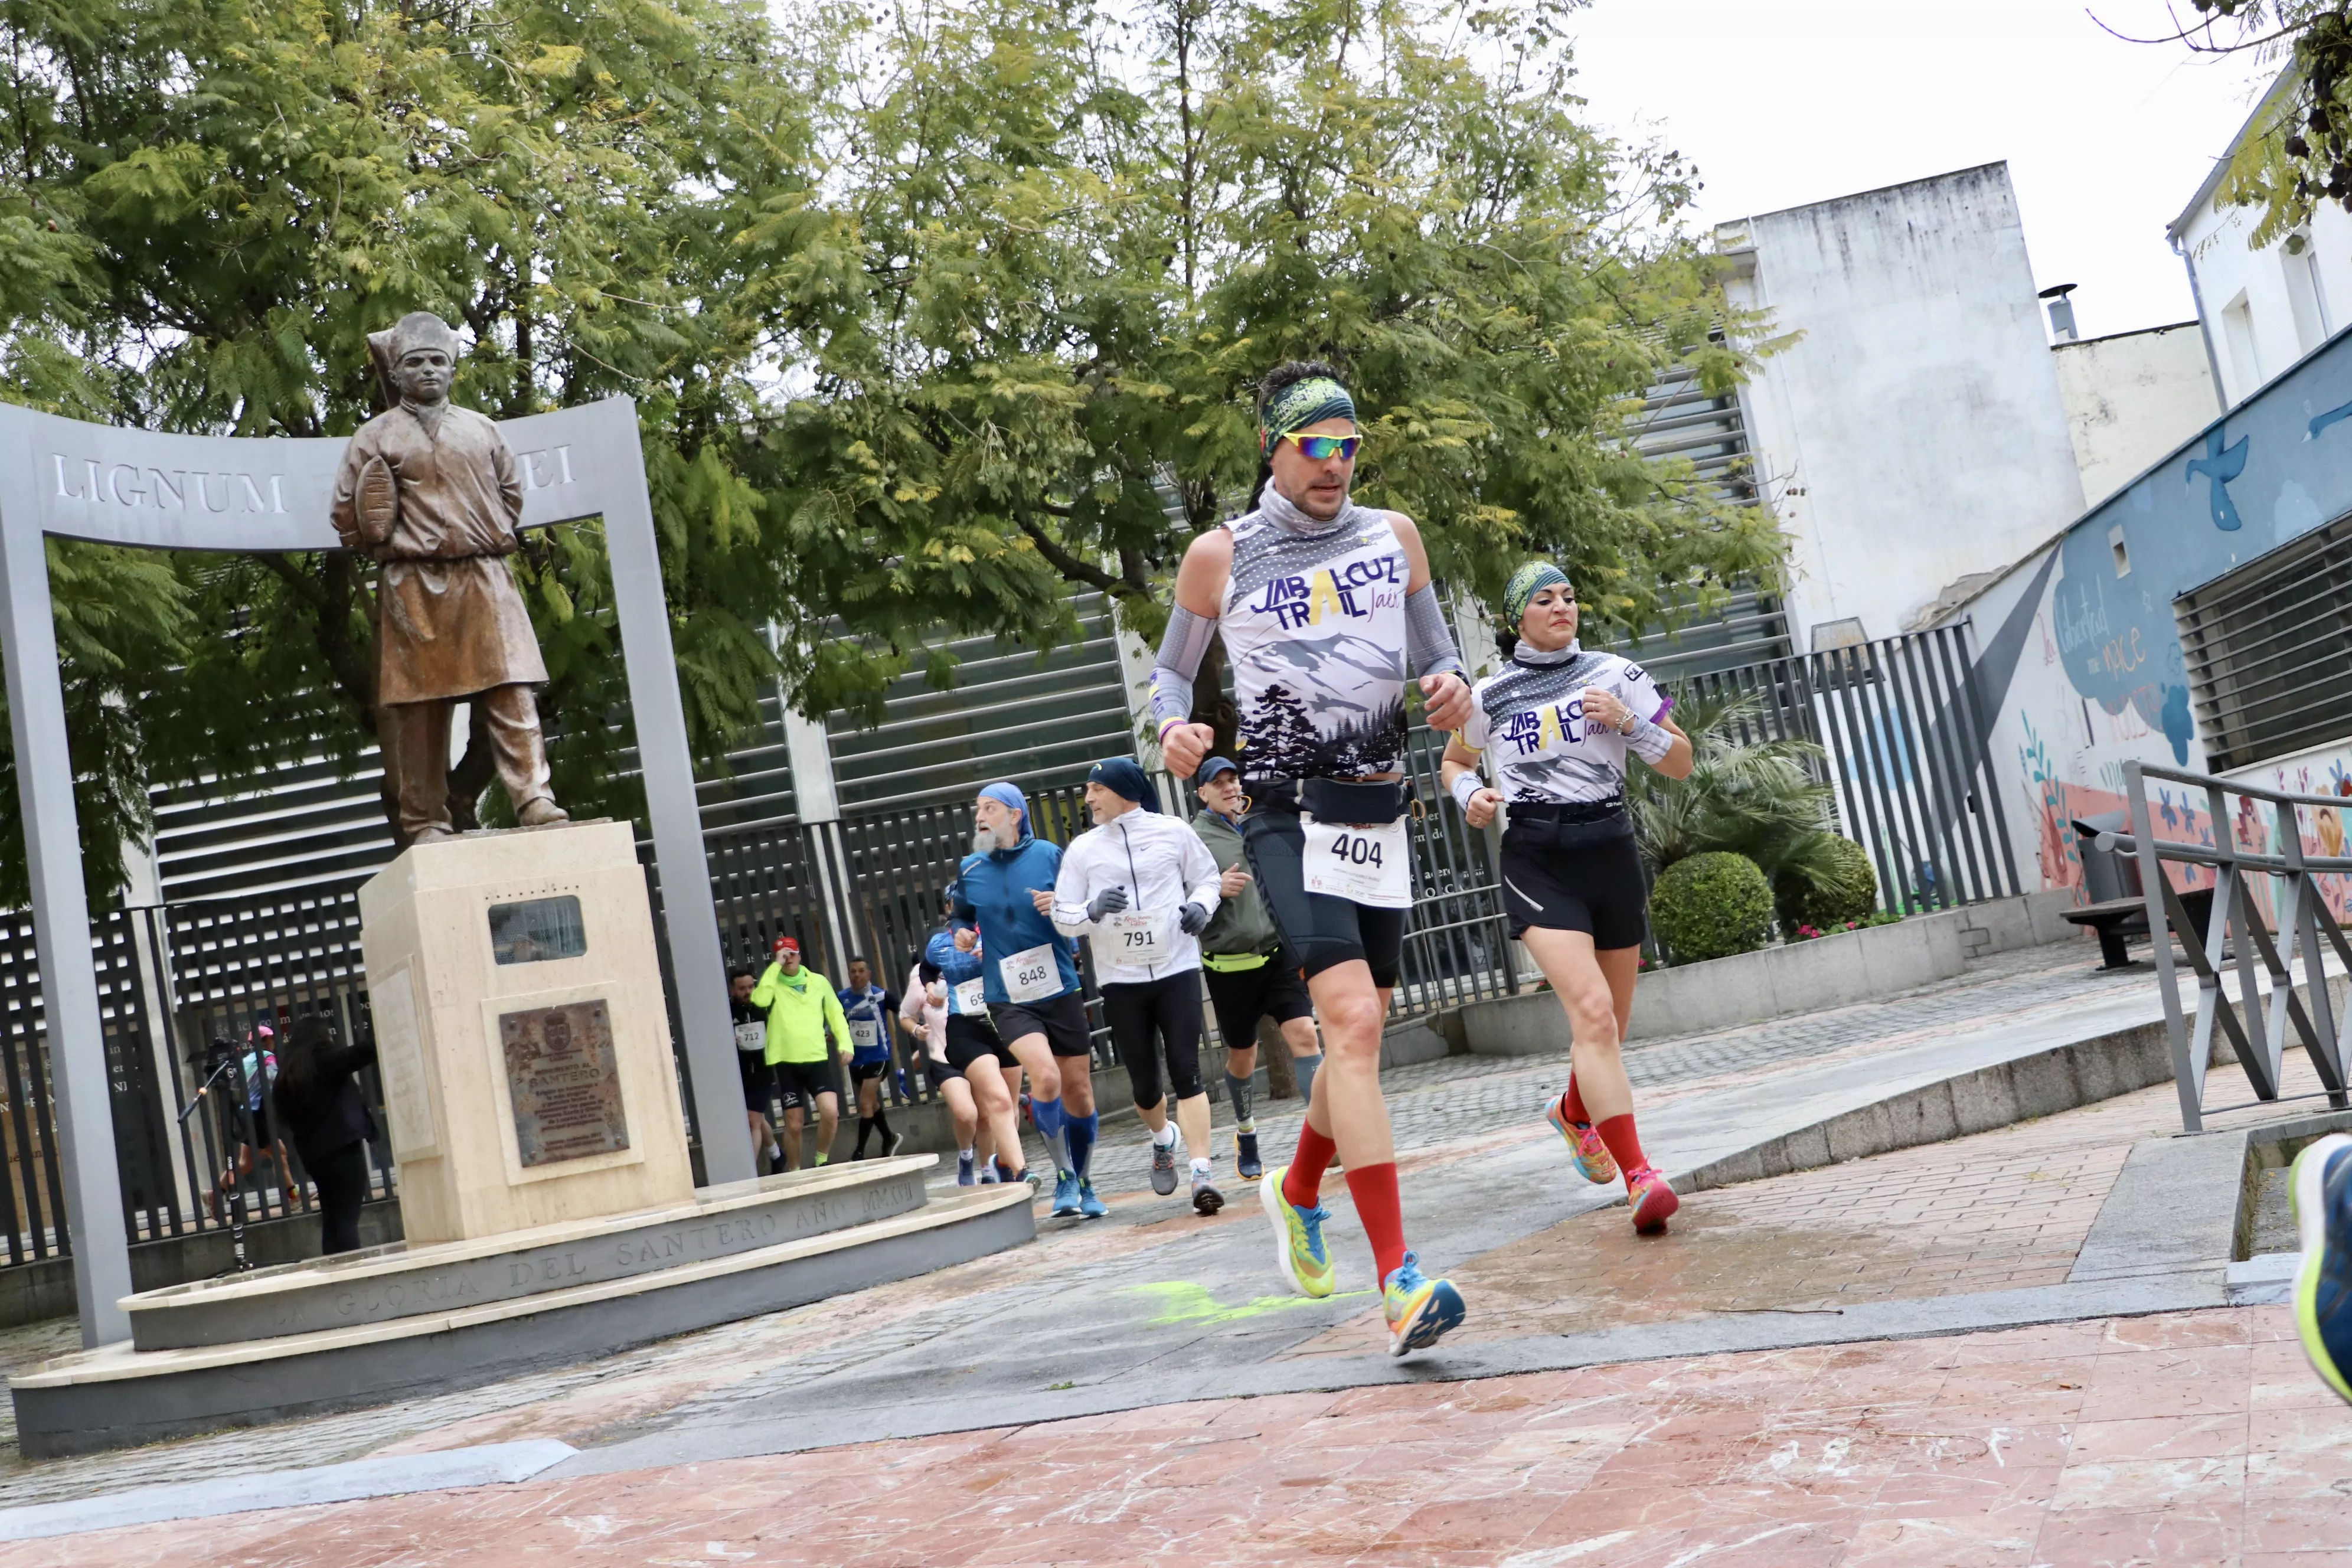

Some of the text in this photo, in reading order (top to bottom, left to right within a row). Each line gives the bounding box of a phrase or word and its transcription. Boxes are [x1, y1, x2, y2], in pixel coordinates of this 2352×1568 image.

[52, 444, 577, 514] LIGNUM EI
[1250, 557, 1400, 614] JABALCUZ
[1269, 582, 1368, 630] TRAIL
[1501, 699, 1585, 742] JABALC
[1514, 714, 1582, 756] TRAIL
[1331, 833, 1383, 869] 404
[1123, 930, 1155, 947] 791
[1019, 965, 1047, 985] 848
[970, 992, 984, 1007] 69
[744, 1032, 759, 1041] 712
[529, 1068, 600, 1087] SANTERO
[535, 1064, 579, 1076] MONUMENTO
[270, 1305, 308, 1326] LA
[336, 1273, 479, 1315] GLORIA
[509, 1253, 587, 1287] DEL
[617, 1214, 776, 1266] SANTERO
[797, 1197, 845, 1229] AÑO
